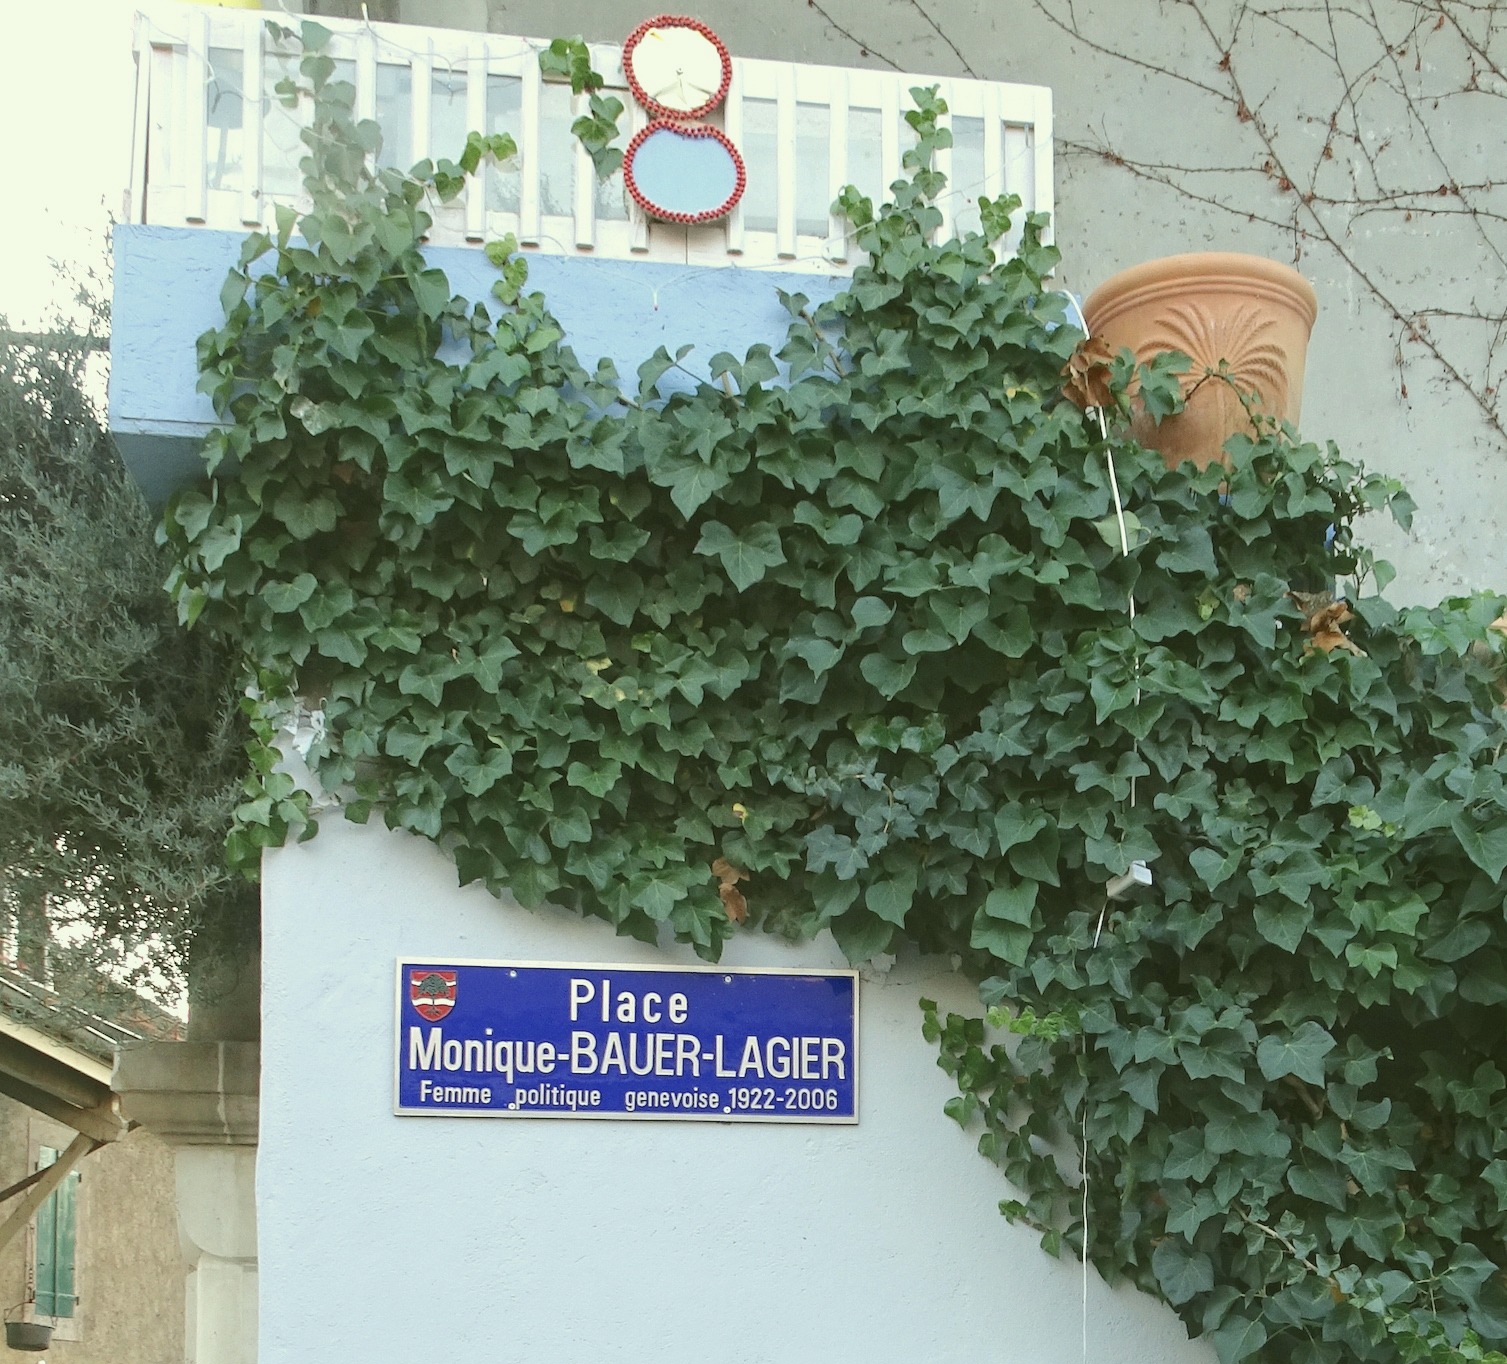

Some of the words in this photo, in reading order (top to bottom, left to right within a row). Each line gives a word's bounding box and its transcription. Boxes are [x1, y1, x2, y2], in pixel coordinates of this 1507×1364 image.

[569, 978, 689, 1024] Place
[409, 1026, 846, 1084] Monique-BAUER-LAGIER
[420, 1080, 492, 1104] Femme
[514, 1083, 601, 1111] politique
[625, 1087, 719, 1112] genevoise
[729, 1087, 838, 1110] 1922-2006
